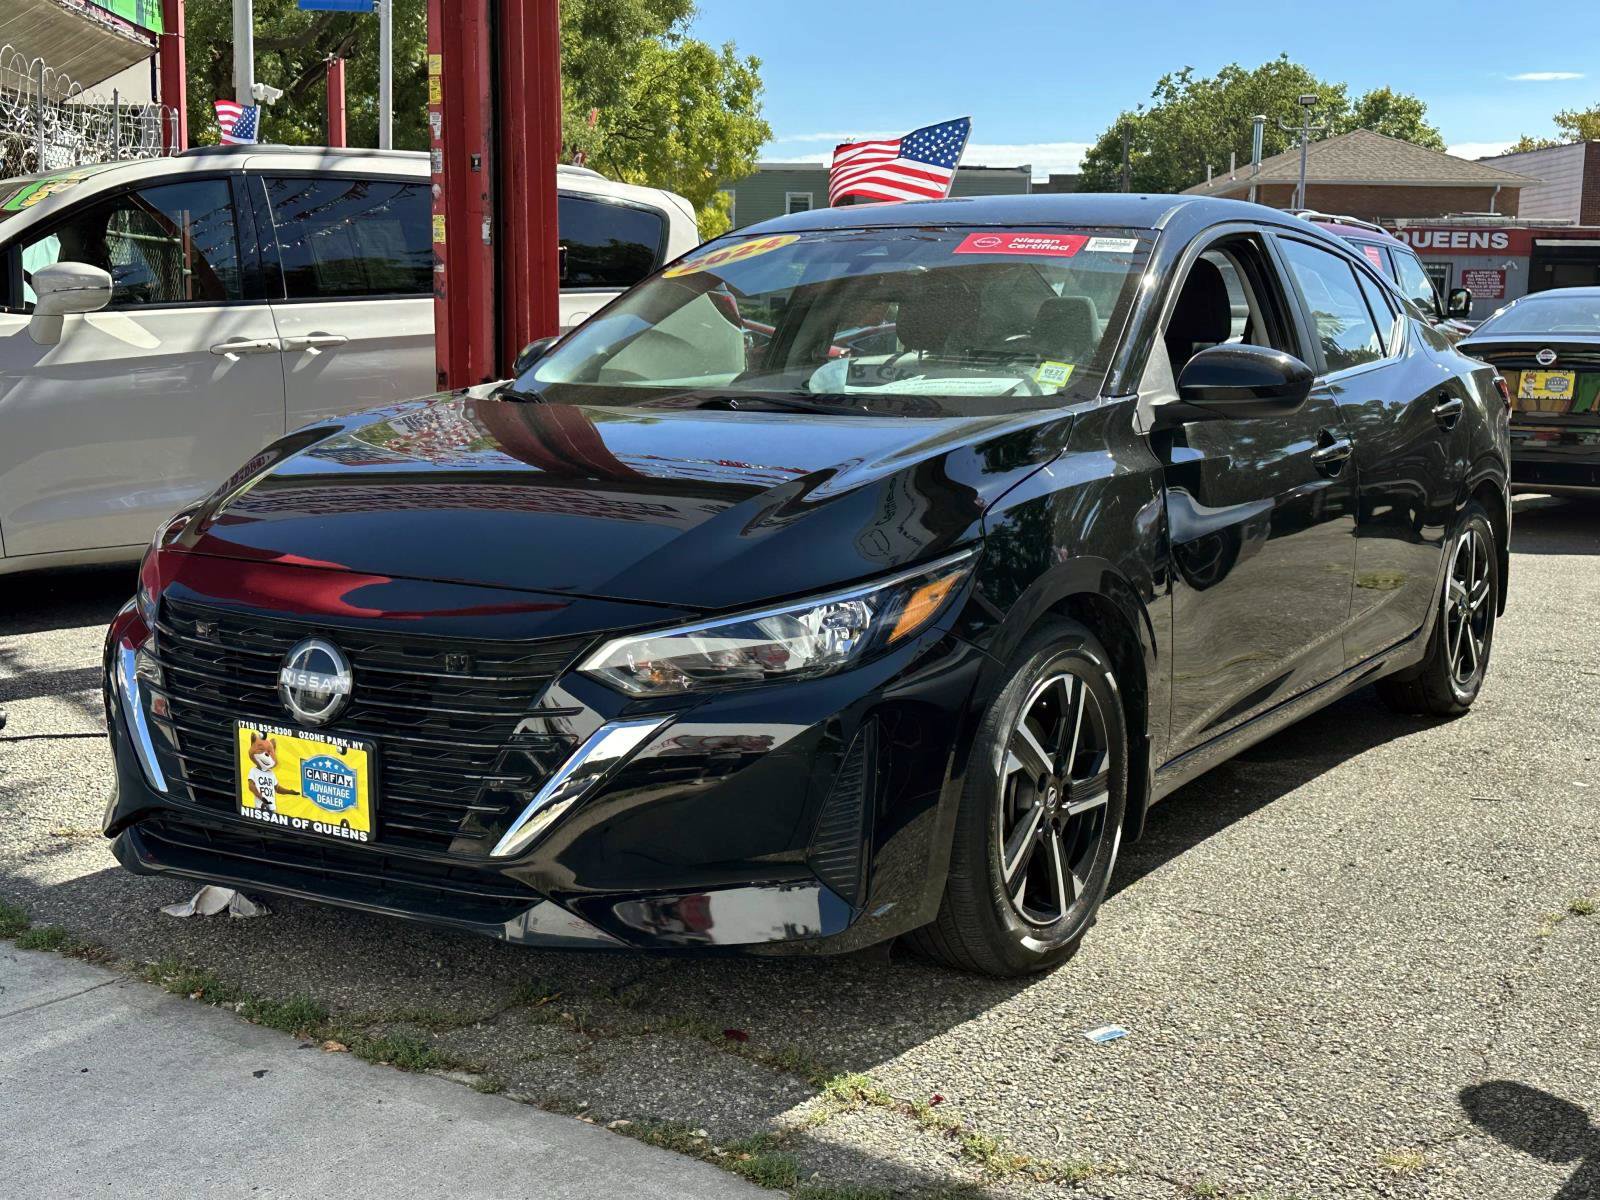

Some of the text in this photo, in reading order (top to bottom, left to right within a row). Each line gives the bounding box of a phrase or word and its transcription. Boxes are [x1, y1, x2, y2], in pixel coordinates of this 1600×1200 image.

[677, 236, 783, 274] 2024
[1008, 243, 1069, 251] Certified
[282, 670, 349, 690] NISSAN
[298, 731, 325, 743] OZONE
[352, 741, 364, 750] NY
[258, 776, 273, 786] CAR
[305, 768, 353, 788] CARFAX
[260, 787, 274, 798] FOX
[309, 783, 351, 799] ADVANTAGE
[316, 794, 344, 808] DEALER
[241, 806, 369, 842] NISSAN OF QUEENS
